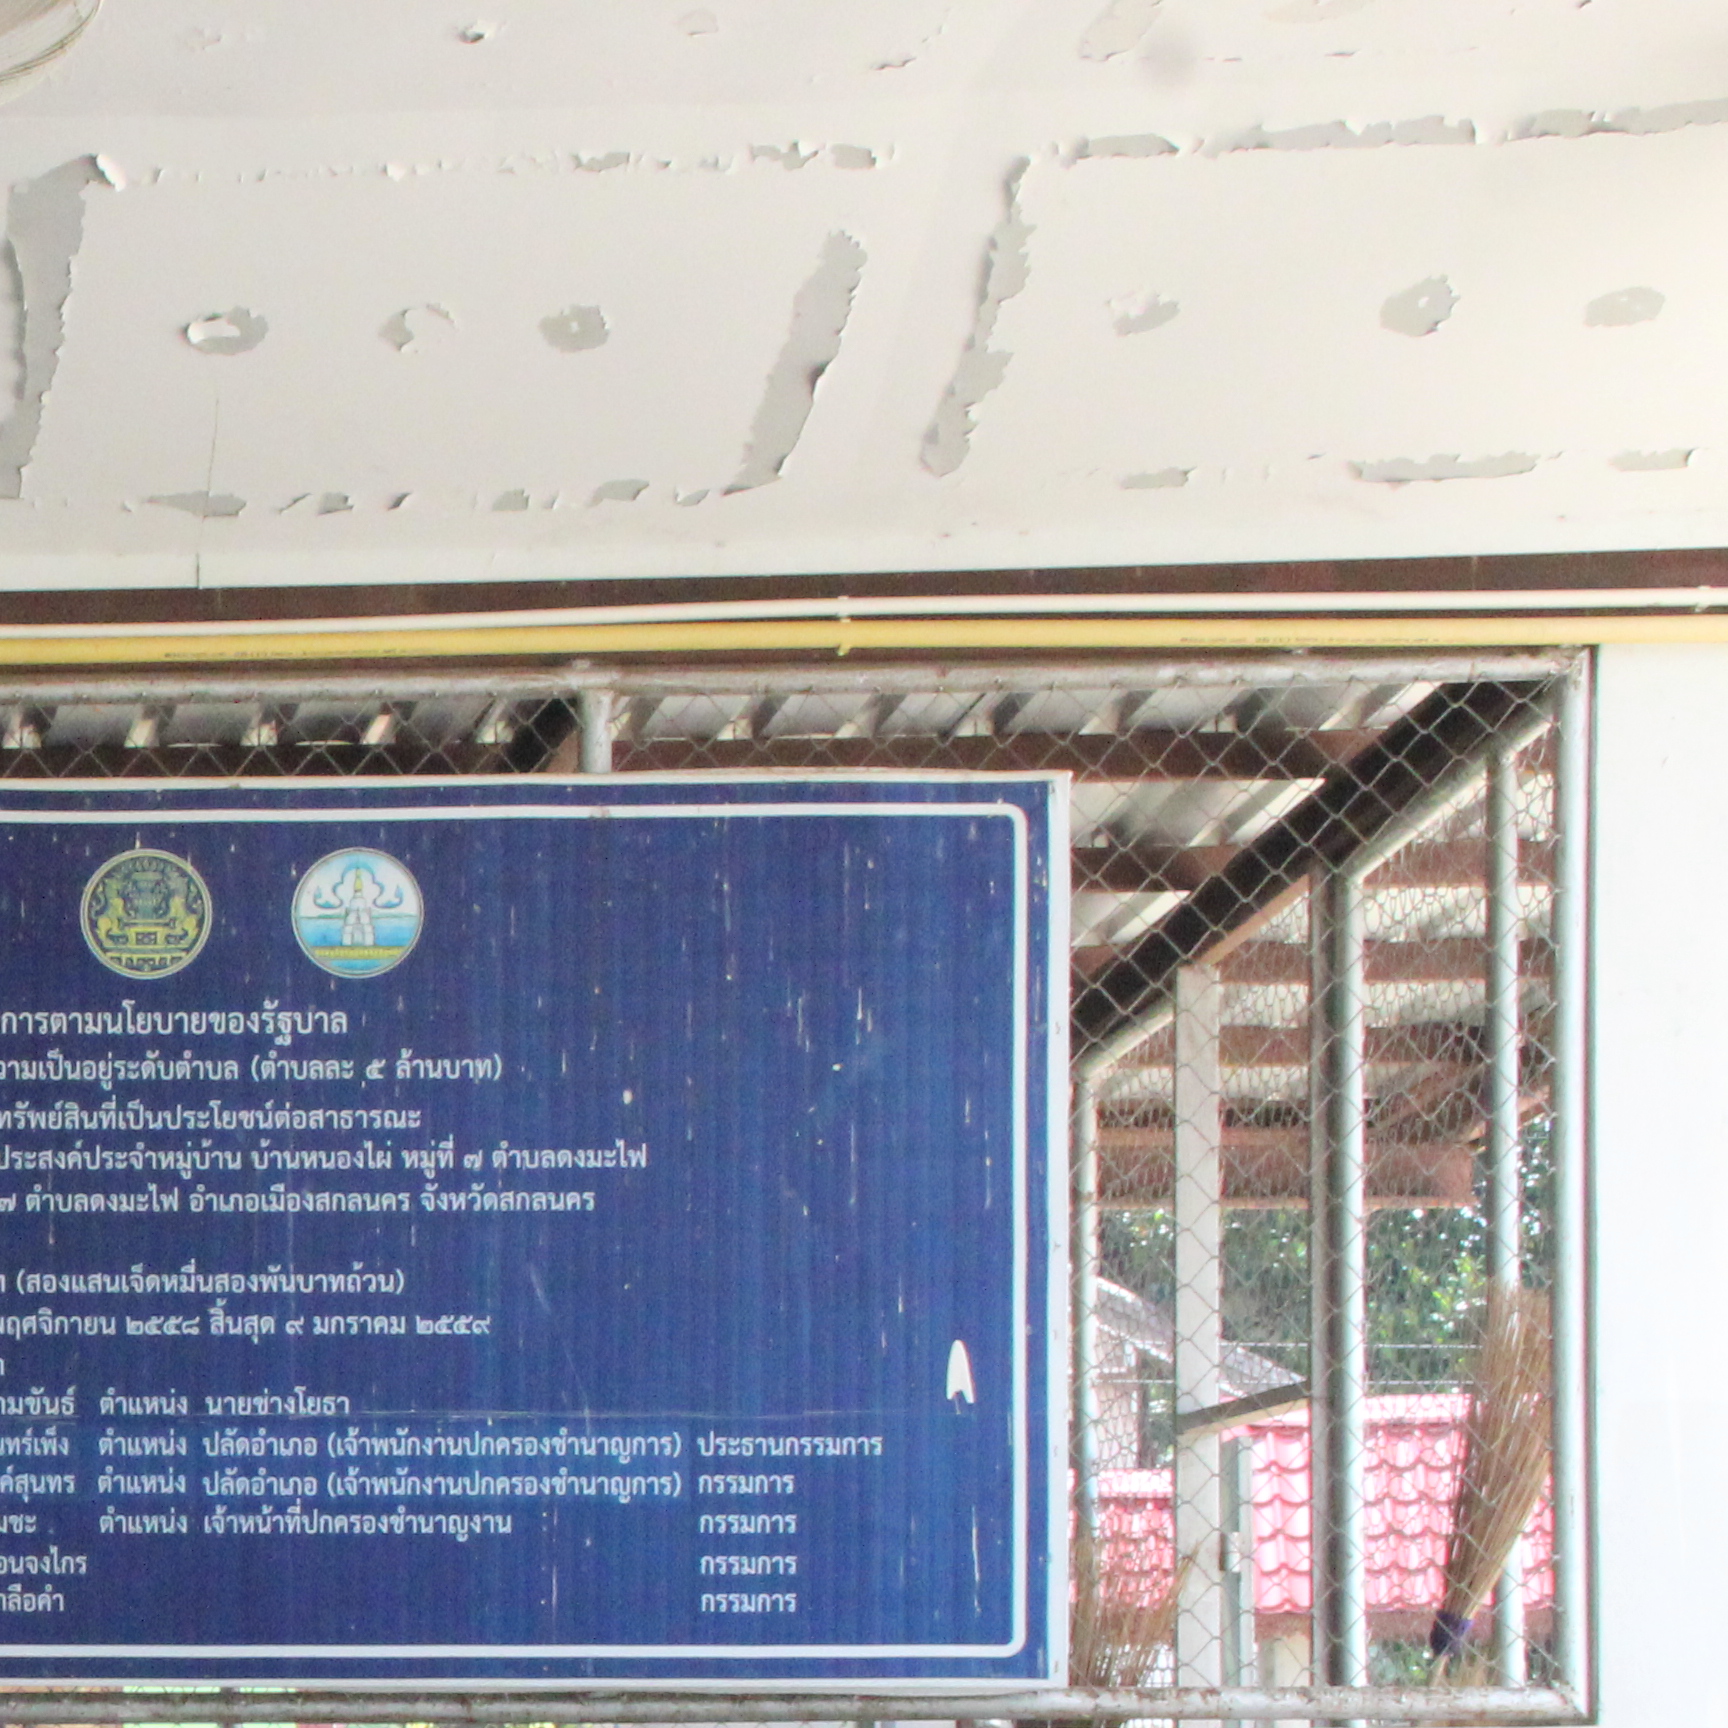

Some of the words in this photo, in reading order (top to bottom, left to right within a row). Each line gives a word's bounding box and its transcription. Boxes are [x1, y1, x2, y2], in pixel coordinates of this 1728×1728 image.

[250, 1049, 355, 1082] (ตำบลละ
[365, 1058, 387, 1080] ๕
[395, 1047, 503, 1083] ล้านบาท)
[250, 1138, 392, 1170] บ้านหนองไผ่
[401, 1134, 455, 1180] หมู่ที่
[463, 1149, 483, 1171] ๗
[492, 1138, 648, 1169] ตำบลดงมะไฟ
[25, 1182, 180, 1213] ตำบลดงมะไฟ
[189, 1182, 411, 1213] อำเภอเมืองสกลนคร
[420, 1180, 596, 1212] จังหวัดสกลนคร
[16, 1258, 405, 1295] (สองแสนเจ็ดหมื่นสองพันบาทถ้วน)
[208, 1298, 276, 1344] สิ้นสุด
[313, 1315, 407, 1335] มกราคม
[99, 1387, 189, 1416] ตำแหน่ง
[205, 1385, 351, 1417] นายช่างโยธา
[98, 1427, 188, 1456] ตำแหน่ง
[202, 1427, 318, 1457] ปลัดอำเภอ
[327, 1426, 682, 1465] (เจ้าพนักงานปกครองชำนาญการ)
[697, 1430, 884, 1457] ประธานกรรมการ
[97, 1465, 187, 1494] ตำแหน่ง
[203, 1466, 318, 1496] ปลัดอำเภอ
[327, 1465, 683, 1504] (เจ้าพนักงานปกครองชำนาญการ)
[698, 1474, 795, 1494] กรรมการ
[99, 1505, 188, 1534] ตำแหน่ง
[203, 1497, 513, 1543] เจ้าหน้าที่ปกครองชำนาญงาน
[700, 1513, 798, 1534] กรรมการ
[700, 1555, 798, 1575] กรรมการ
[701, 1592, 797, 1613] กรรมการ
